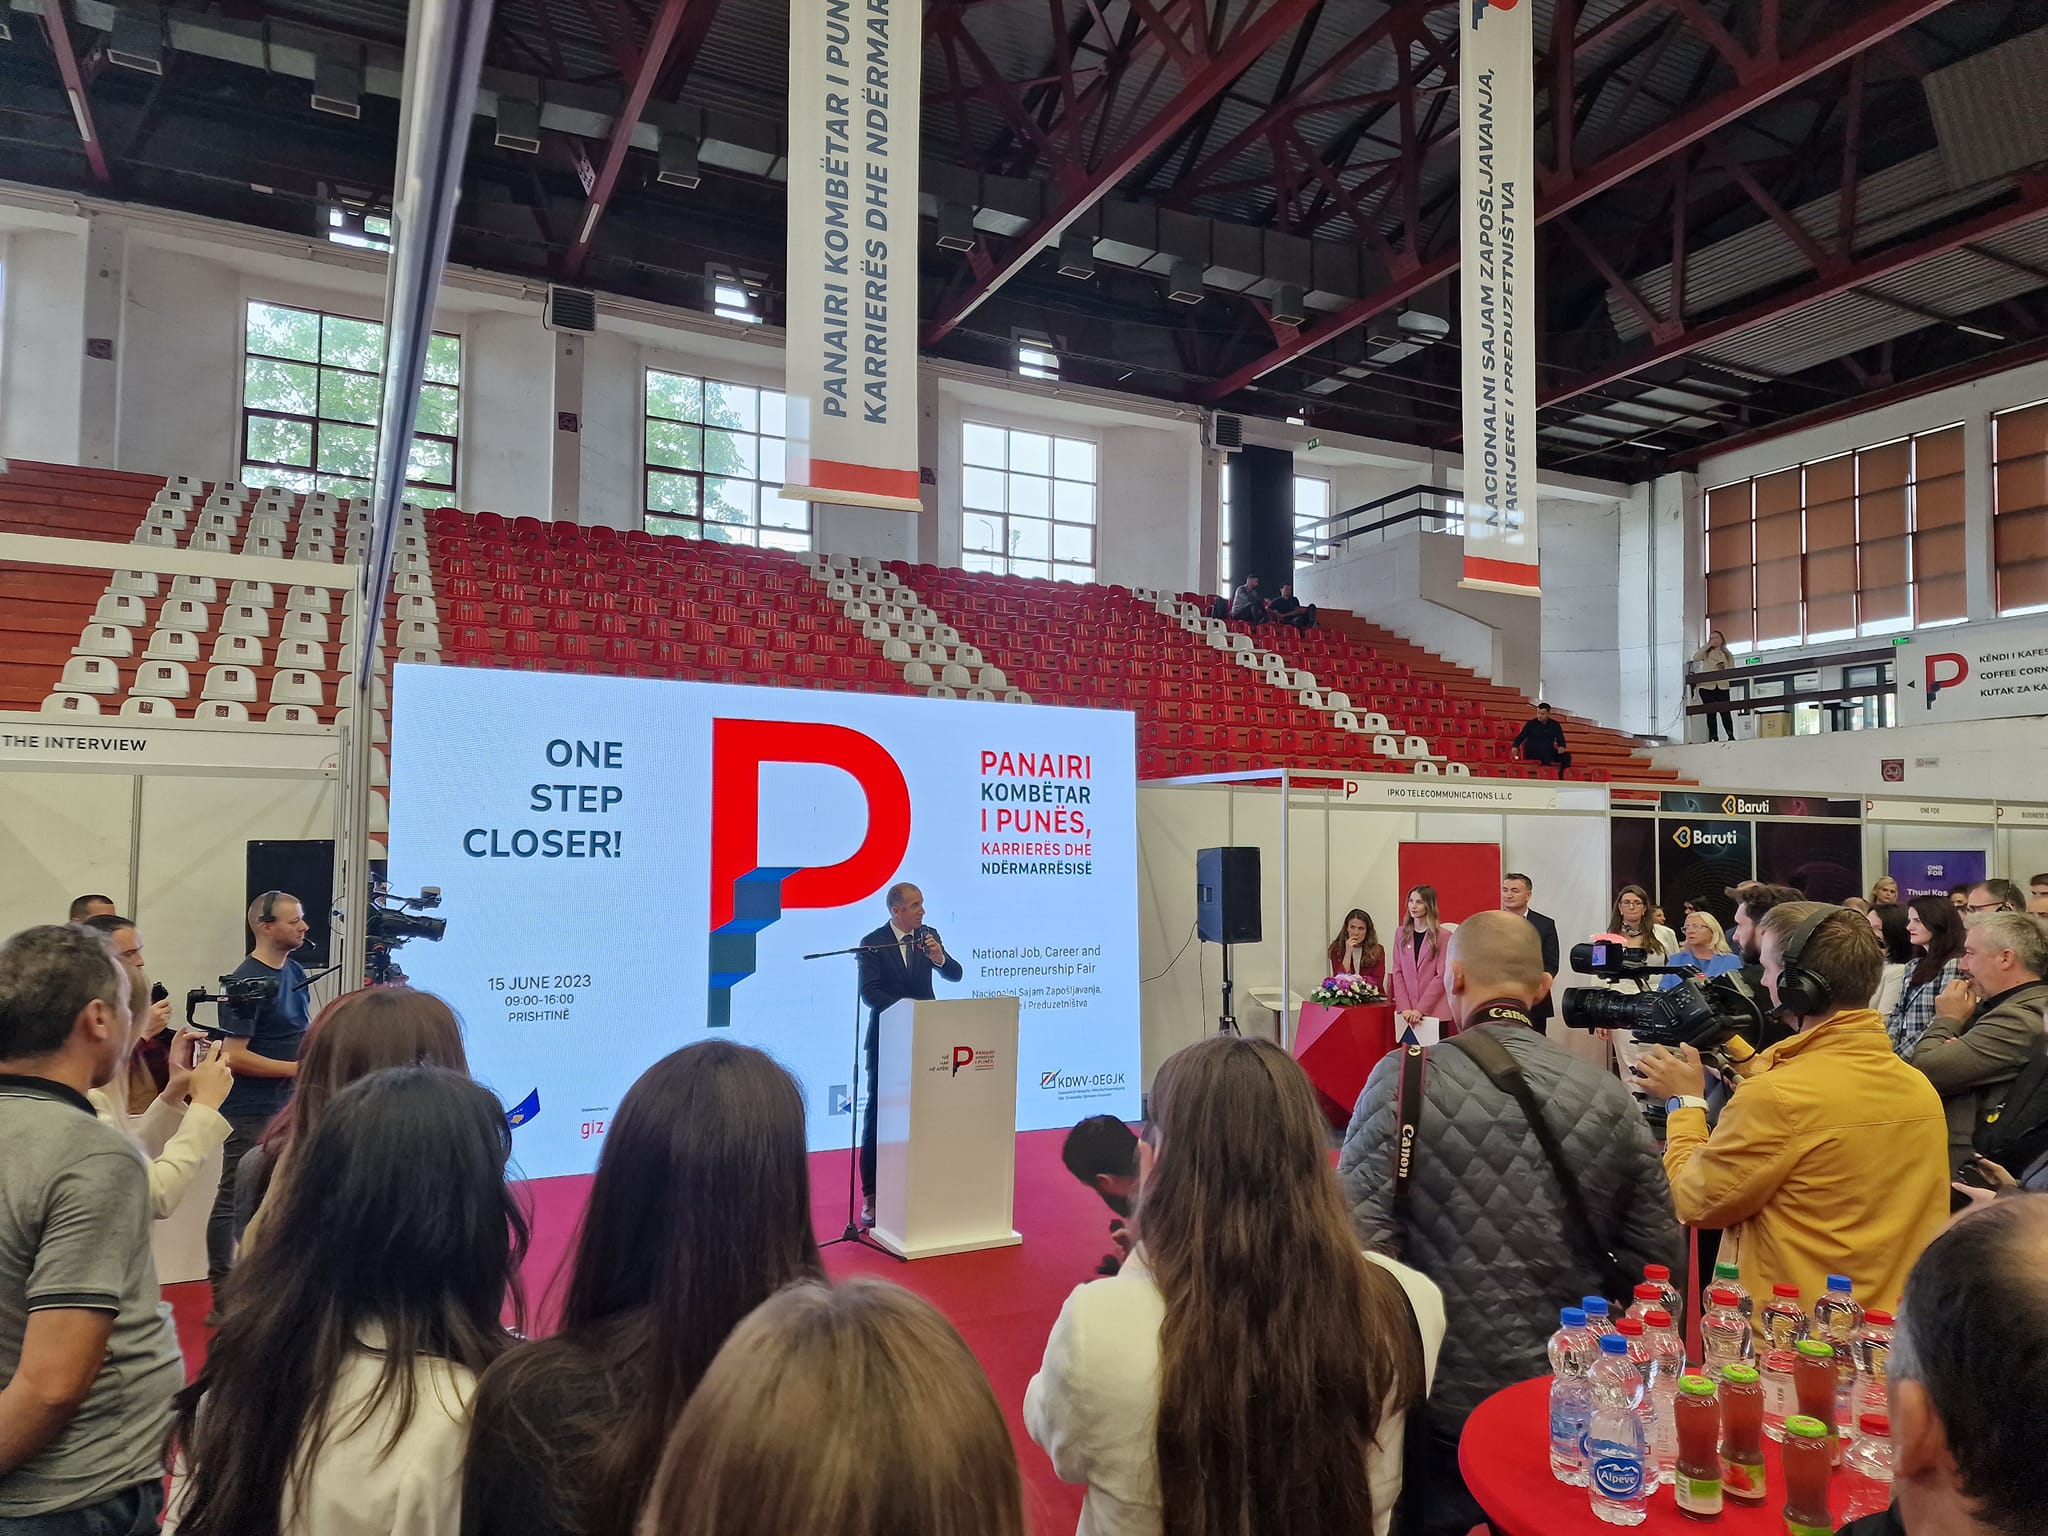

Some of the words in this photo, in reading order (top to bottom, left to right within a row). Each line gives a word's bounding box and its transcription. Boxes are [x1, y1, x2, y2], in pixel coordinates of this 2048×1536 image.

[826, 0, 850, 67] PUN
[826, 74, 849, 86] I
[861, 0, 889, 156] NDËRMAR
[1476, 68, 1495, 280] ZAPOŠLJAVANJA,
[820, 93, 849, 275] KOMBËTAR
[866, 162, 888, 231] DHE
[1498, 182, 1515, 394] PREDUZETNIŠTVA
[860, 239, 888, 424] KARRIERËS
[1481, 285, 1495, 371] SAJAM
[824, 283, 848, 417] PANAIRI
[1504, 398, 1514, 408] I
[1483, 376, 1498, 527] NACIONALNI
[1980, 669, 2017, 680] COFFEE
[1980, 687, 2015, 697] KUTAK
[2017, 685, 2031, 694] ZA
[2, 735, 39, 748] THE
[45, 736, 147, 751] INTERVIEW
[545, 739, 623, 769] ONE
[980, 750, 1091, 780] PANAIRI
[530, 784, 623, 813] STEP
[981, 781, 1091, 804] KOMBËTAR
[1387, 789, 1406, 797] IPKO
[1408, 789, 1493, 800] TELECOMMUNICATIONS
[1737, 799, 1770, 814] Baruti
[981, 808, 987, 832] I
[997, 805, 1091, 839] PUNËS,
[463, 828, 622, 858] CLOSER!
[1693, 829, 1737, 845] Baruti
[981, 840, 1061, 856] KARRIERËS
[1065, 843, 1092, 856] DHE
[981, 859, 1092, 875] NDËRMARRËSISË
[972, 946, 1018, 959] National
[1021, 946, 1042, 959] Job,
[1045, 946, 1079, 957] Career
[1082, 944, 1101, 956] and
[981, 963, 1075, 979] Entrepreneurship
[1077, 963, 1096, 974] Fair
[488, 977, 505, 991] 15
[508, 976, 550, 990] JUNE
[554, 974, 592, 988] 2023
[504, 994, 575, 1007] 09:00-16:00
[1018, 987, 1044, 999] Sajam
[1028, 999, 1088, 1010] Preduzetništva
[508, 1008, 570, 1022] PRISHTINË
[1058, 1072, 1125, 1089] KDWV-OEGJK
[581, 1119, 604, 1139] giz
[1399, 1124, 1415, 1178] Canon
[1601, 1471, 1636, 1484] Alpeve
